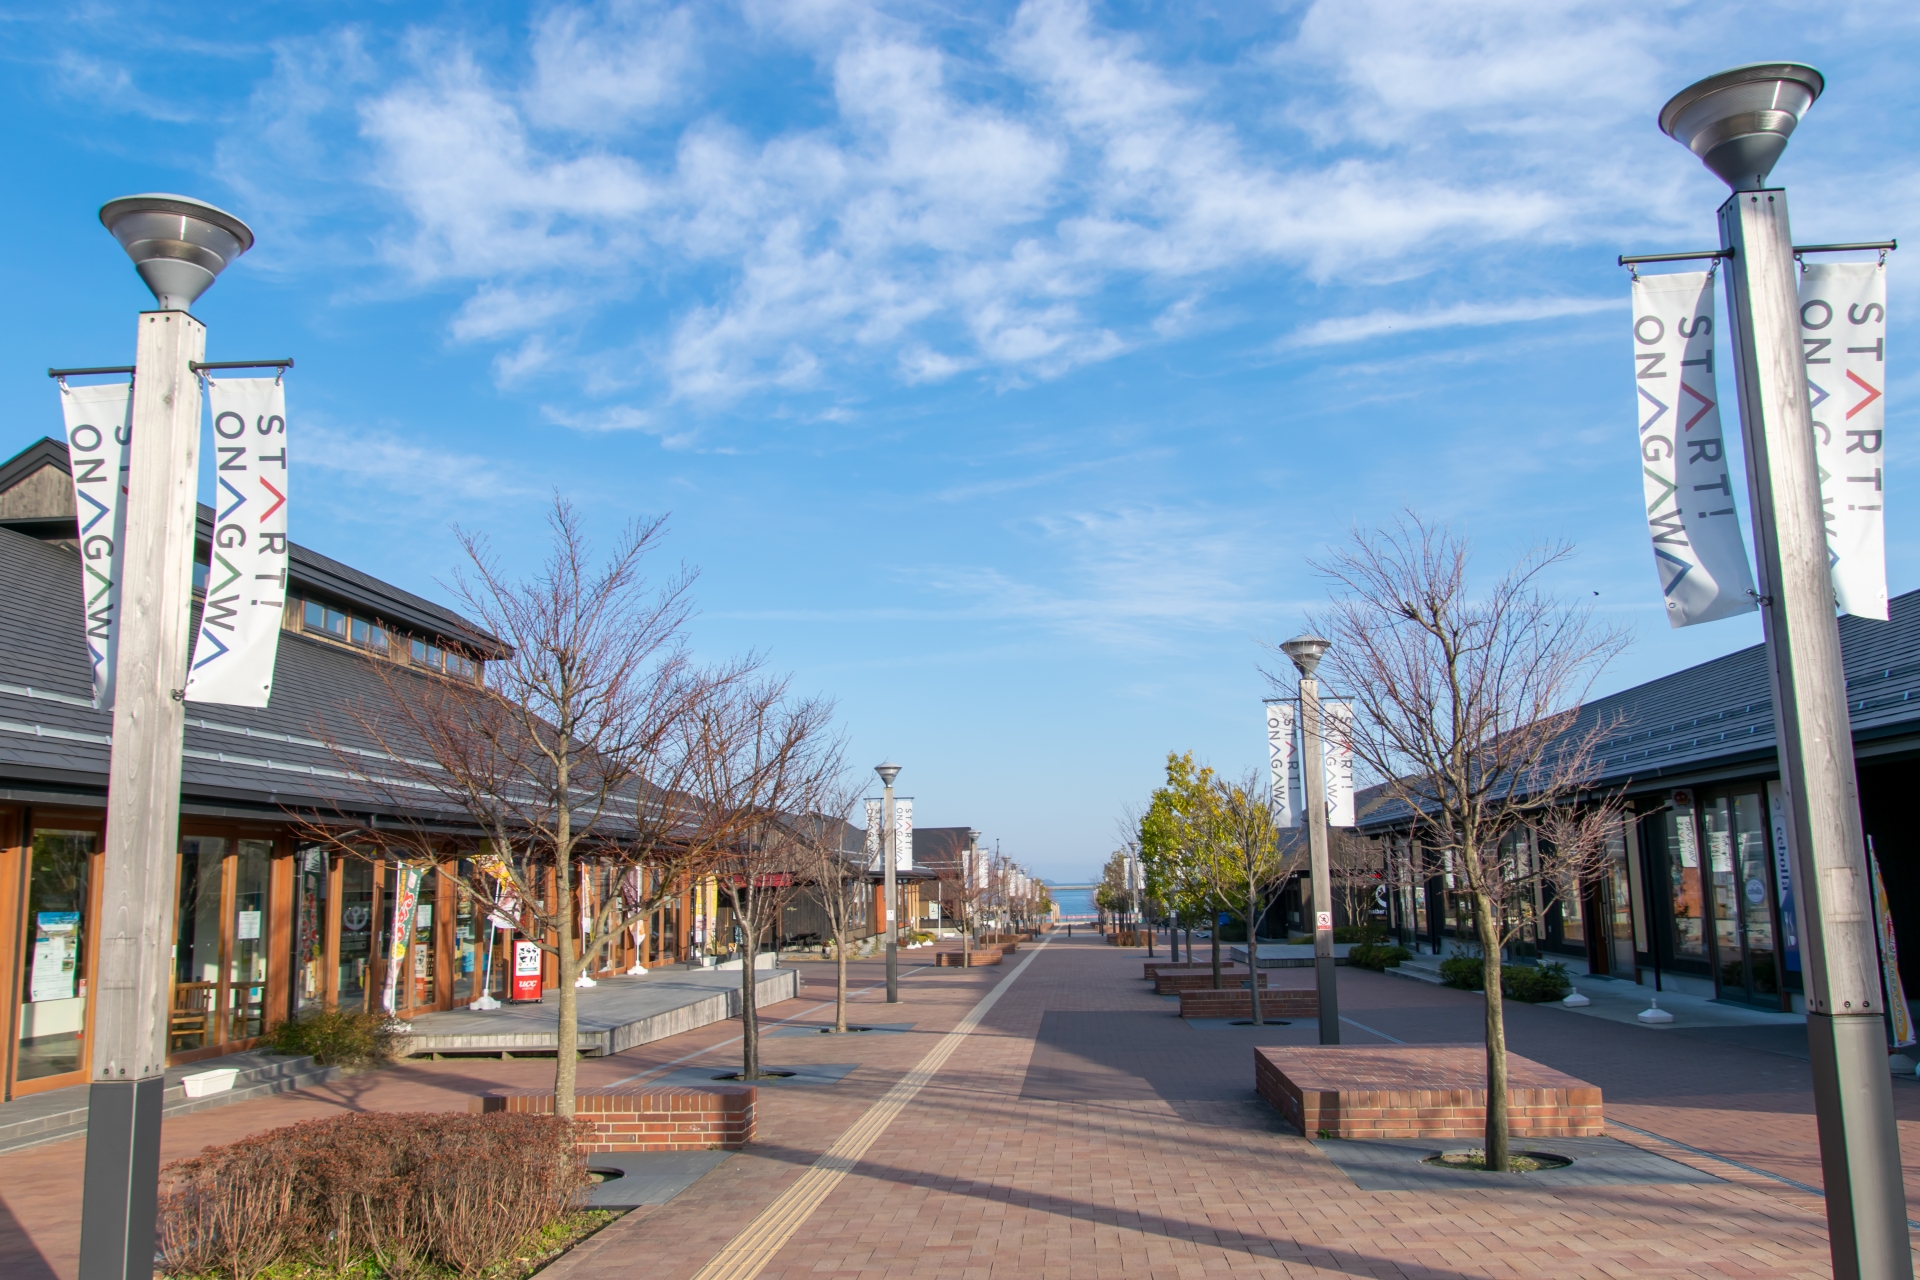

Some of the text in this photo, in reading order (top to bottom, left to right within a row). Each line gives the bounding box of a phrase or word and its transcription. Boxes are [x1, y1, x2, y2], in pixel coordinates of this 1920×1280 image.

[1633, 315, 1694, 597] ONAGAWA
[1678, 315, 1735, 519] START!
[1846, 302, 1884, 512] START!
[70, 424, 115, 684] ONAGAWA
[193, 411, 248, 671] ONAGAWA
[250, 414, 287, 608] START!
[1267, 717, 1286, 816] ONAGAWA
[1283, 718, 1301, 790] START!
[1776, 826, 1790, 891] cebolla
